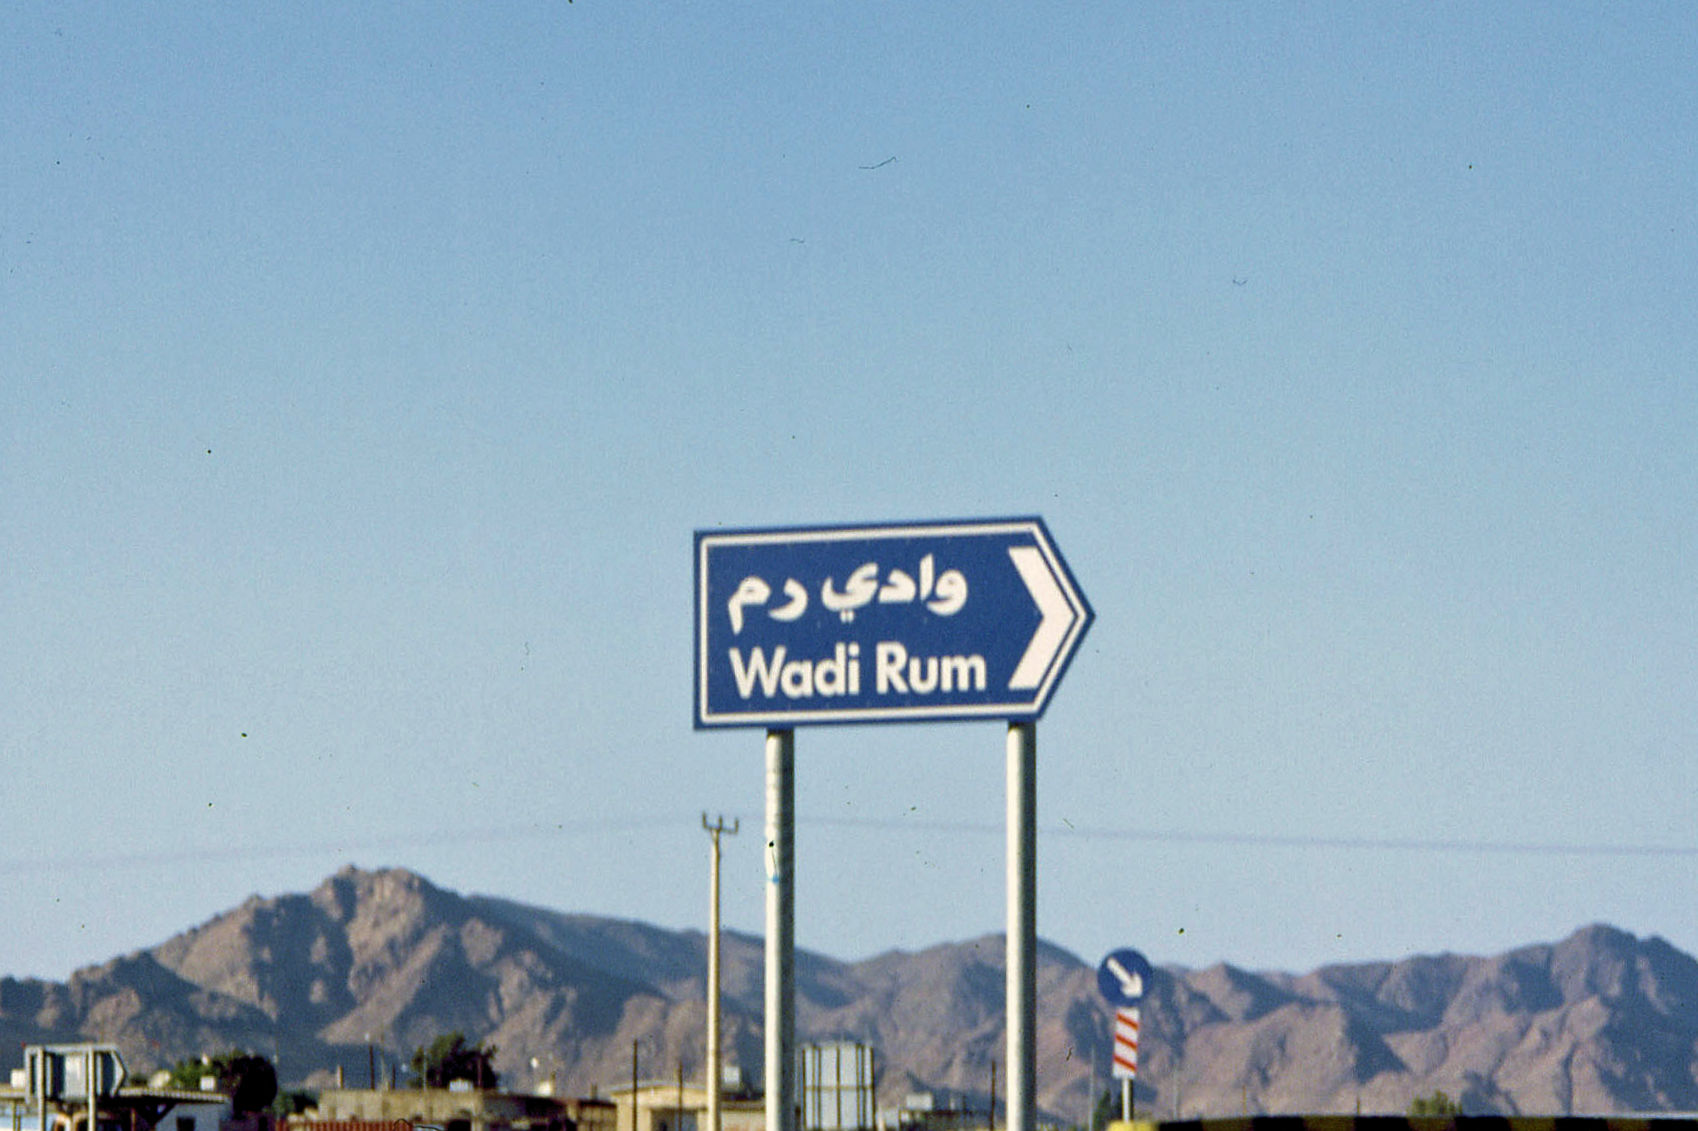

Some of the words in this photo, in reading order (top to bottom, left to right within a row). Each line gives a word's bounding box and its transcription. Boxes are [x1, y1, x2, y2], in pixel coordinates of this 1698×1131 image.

[728, 575, 808, 635] رم
[821, 552, 968, 623] وادي
[728, 642, 860, 699] Wadi
[876, 641, 987, 695] Rum
